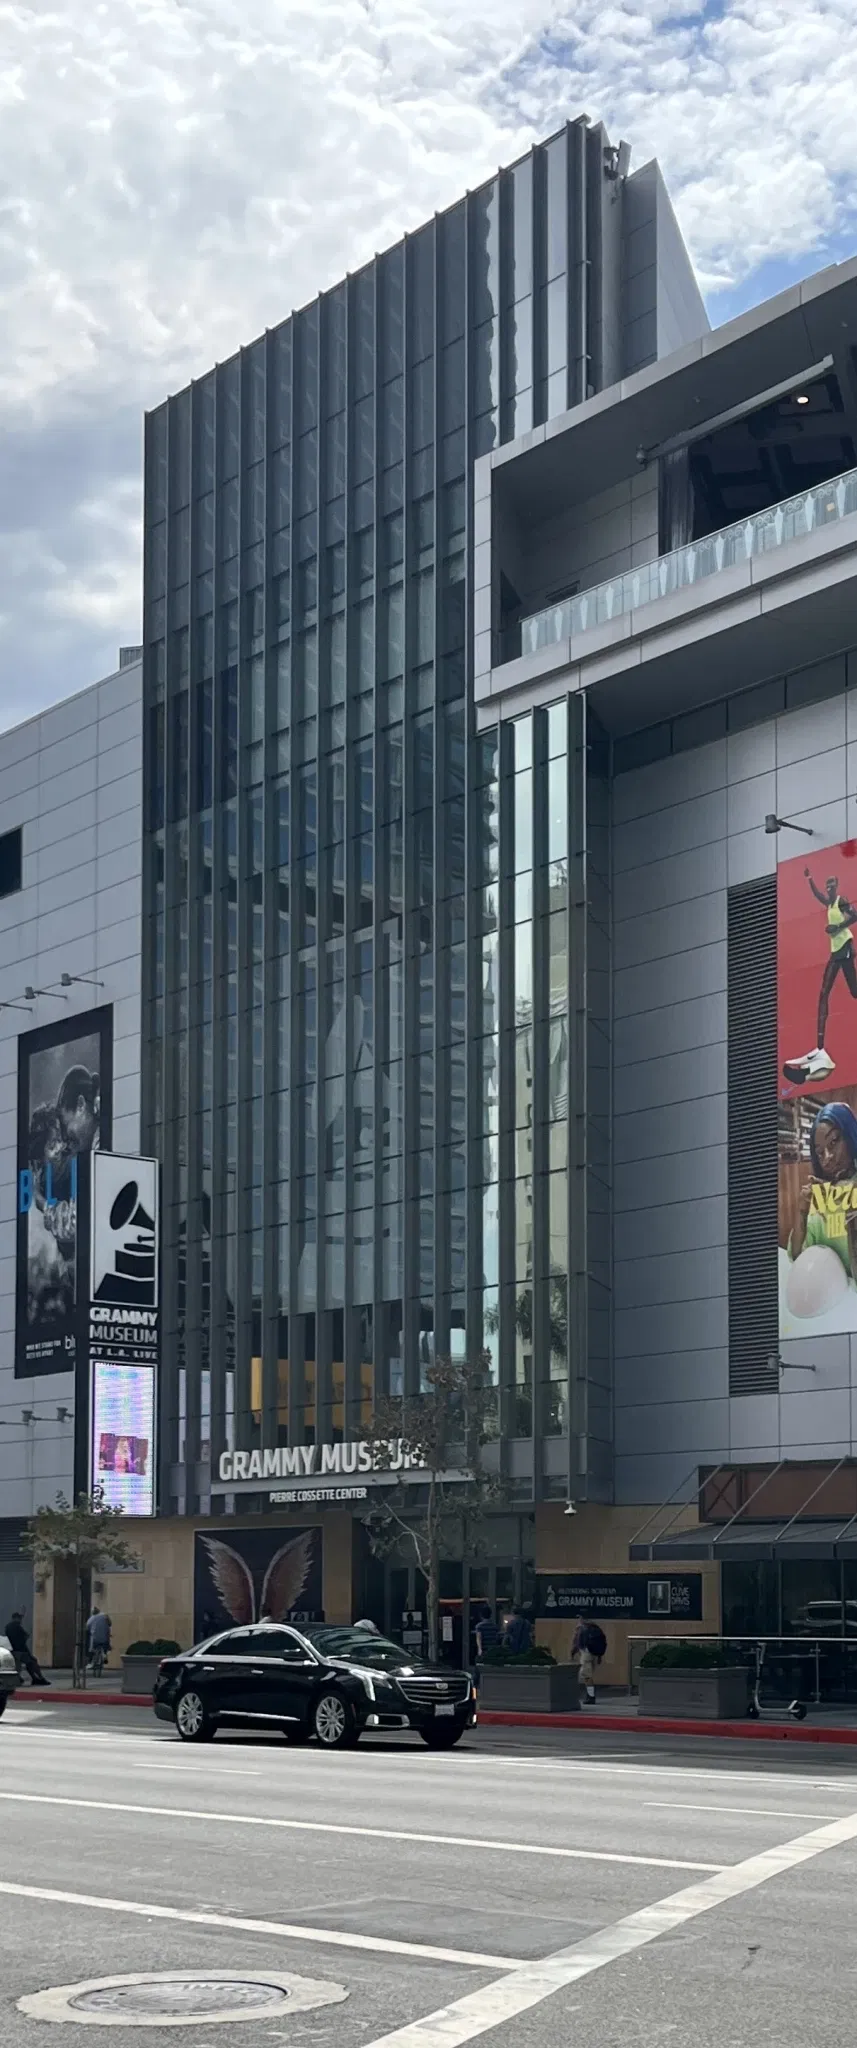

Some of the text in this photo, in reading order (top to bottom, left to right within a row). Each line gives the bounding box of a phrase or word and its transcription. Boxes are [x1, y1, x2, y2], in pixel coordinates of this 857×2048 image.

[89, 1307, 158, 1326] GRAMMY
[89, 1324, 158, 1344] MUSEUM
[89, 1347, 158, 1359] AT L.A. LIVE
[219, 1445, 315, 1480] GRAMMY
[269, 1487, 367, 1503] PIERRE COSSETTE CENTER
[558, 1596, 634, 1607] GRAMMY MUSEUM
